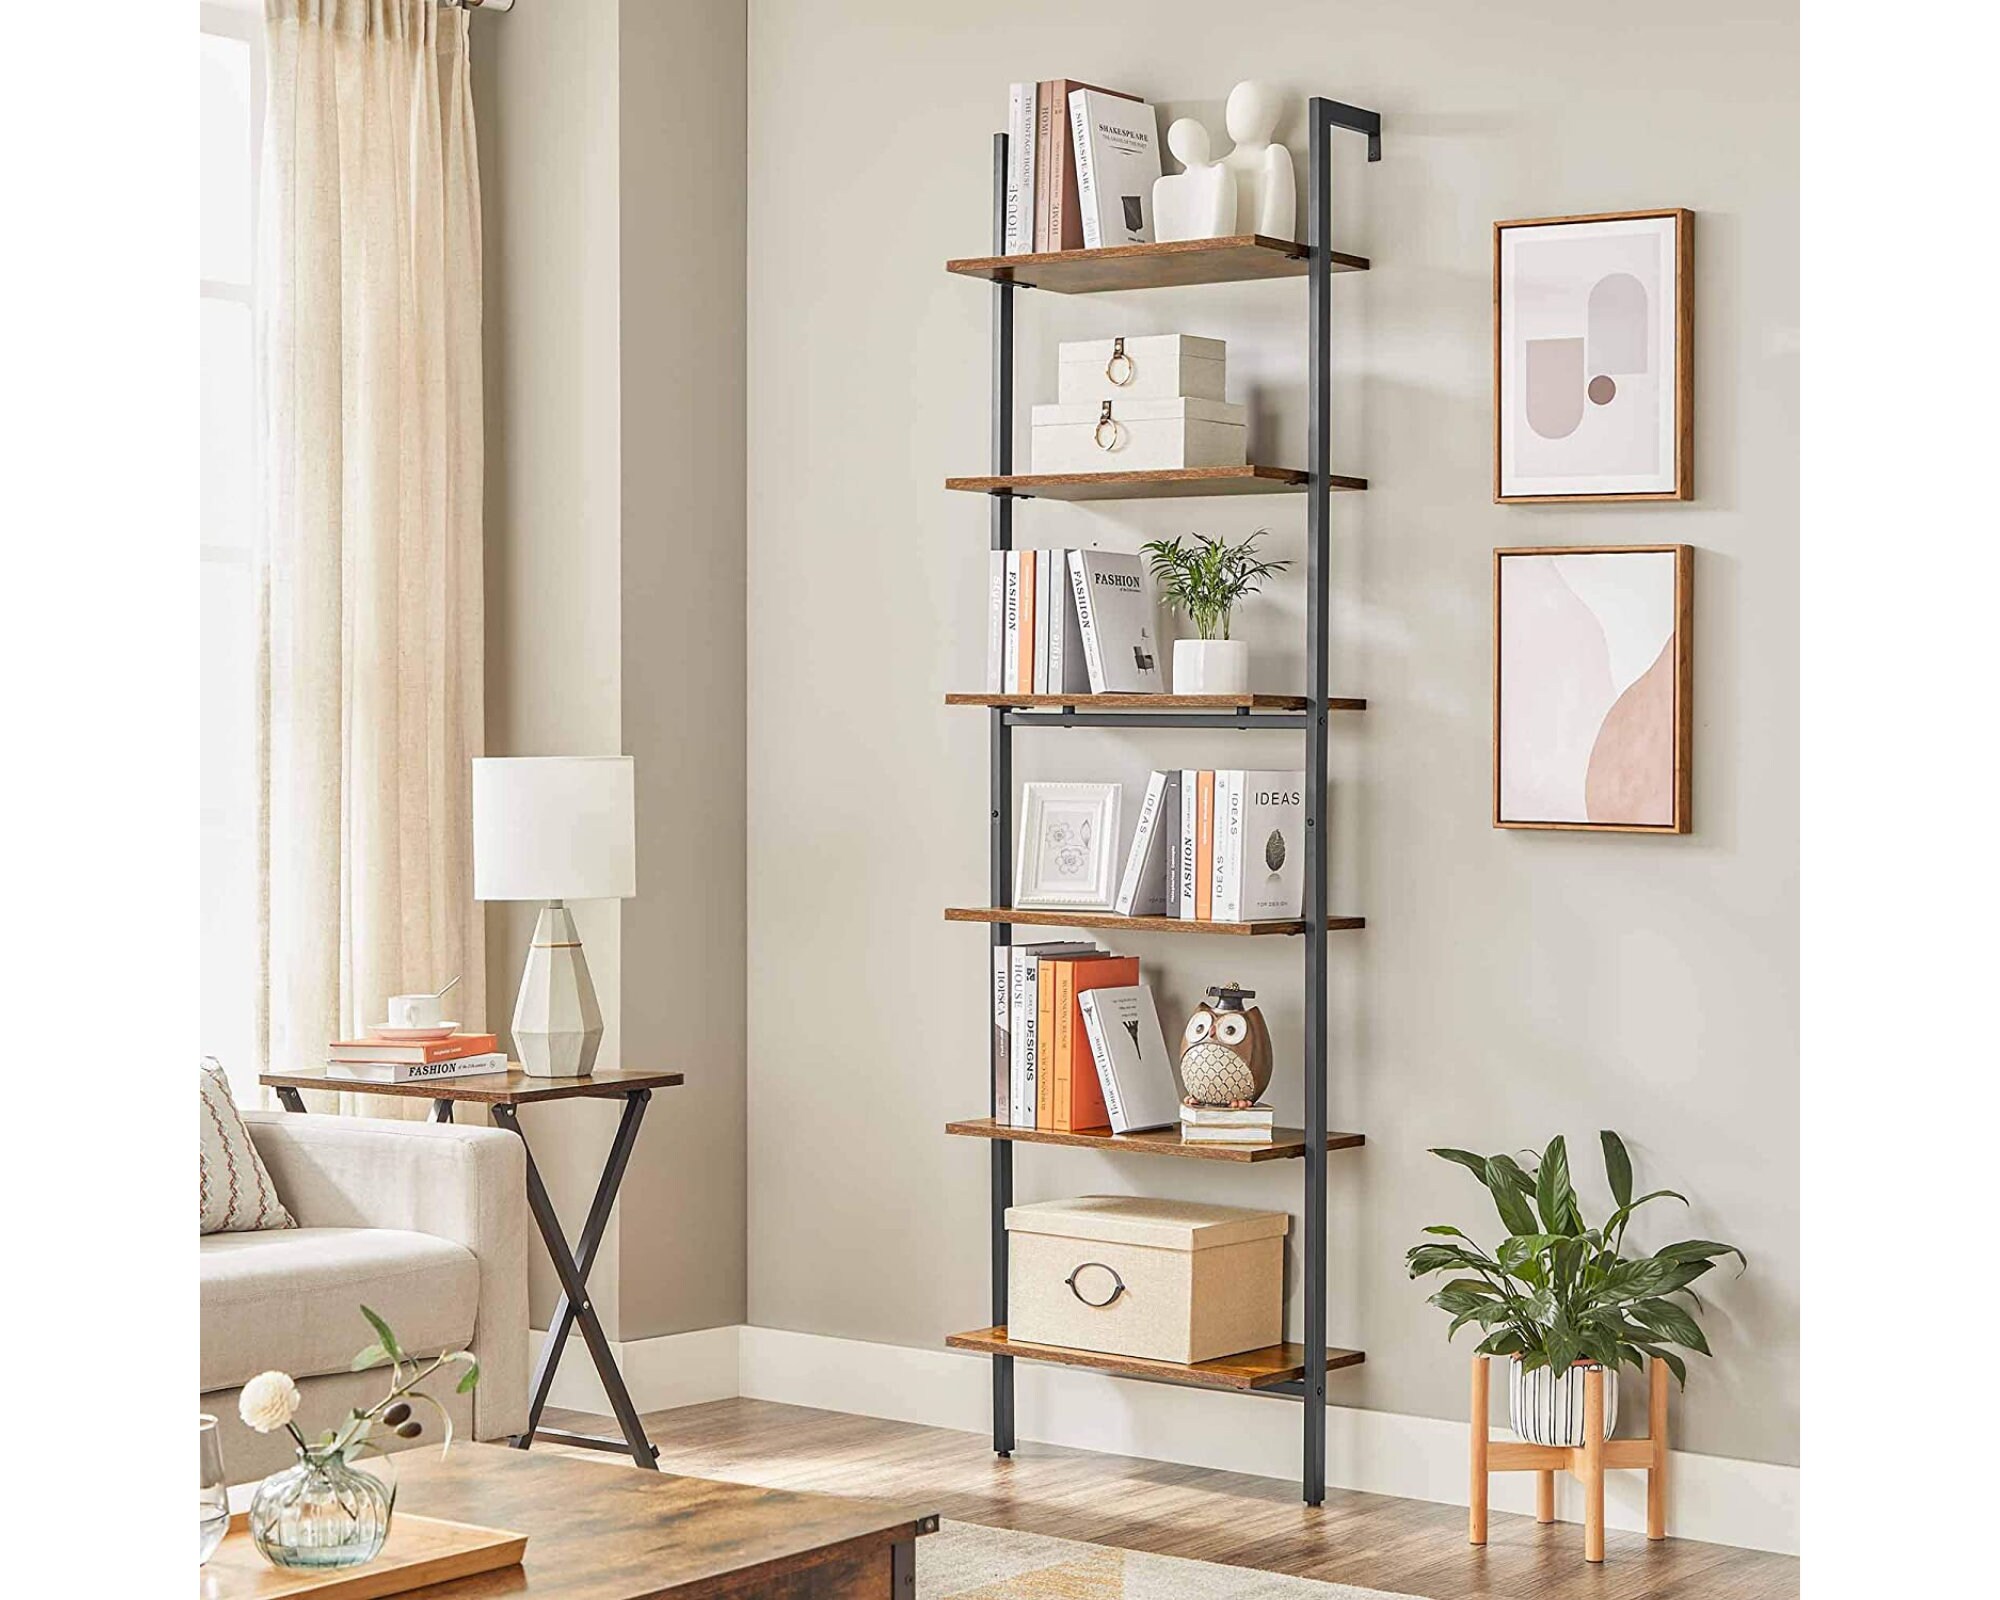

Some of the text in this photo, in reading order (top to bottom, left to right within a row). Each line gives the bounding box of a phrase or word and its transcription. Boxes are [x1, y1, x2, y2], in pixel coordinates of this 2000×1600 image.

[1075, 113, 1091, 193] SHAKESPEARE
[1098, 123, 1149, 142] SHAKESPEARE
[1008, 184, 1018, 237] HOUSE
[1008, 571, 1017, 630] FASHION
[1073, 570, 1091, 629] FASHION
[1094, 572, 1140, 588] FASHION
[1051, 634, 1060, 670] Style
[1139, 793, 1155, 834] IDEAS
[1231, 792, 1239, 835] IDEAS
[1256, 791, 1300, 806] IDEAS
[1184, 836, 1193, 898] FASHION
[1216, 855, 1224, 898] IDEAS
[1014, 965, 1023, 1008] HOUSE
[409, 1062, 457, 1077] FASHION
[1026, 1020, 1035, 1081] DESIGNS
